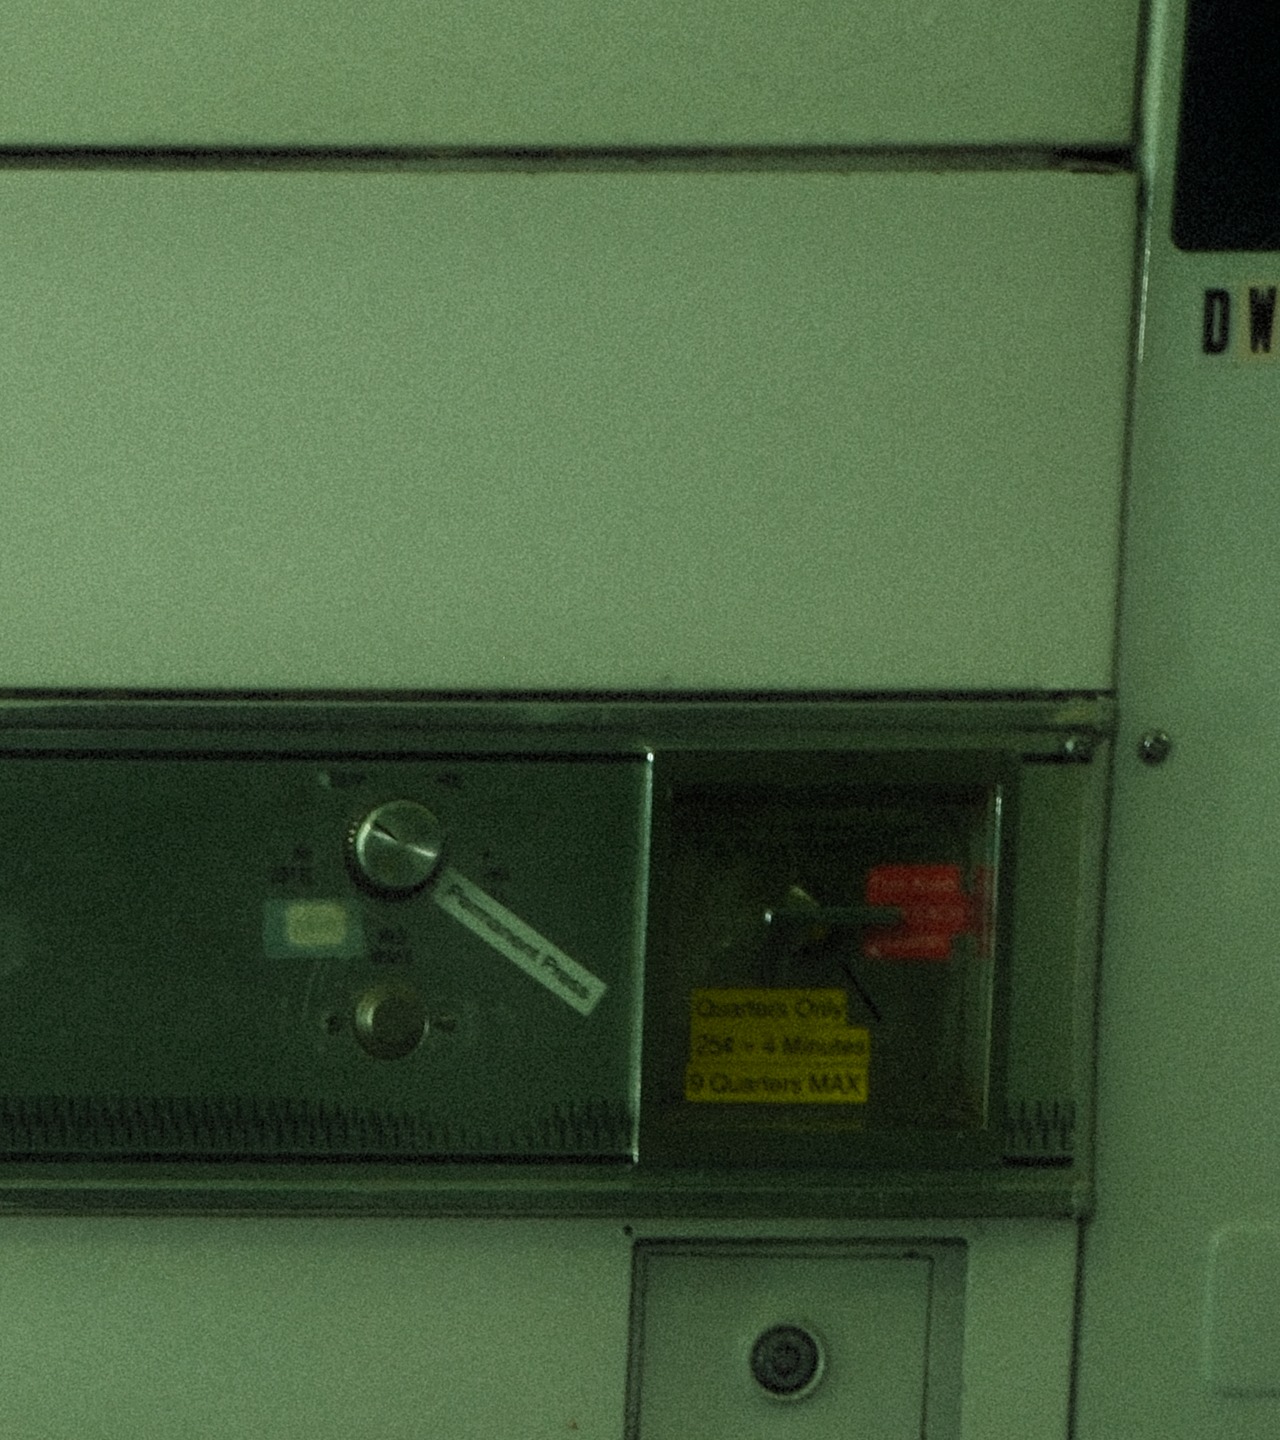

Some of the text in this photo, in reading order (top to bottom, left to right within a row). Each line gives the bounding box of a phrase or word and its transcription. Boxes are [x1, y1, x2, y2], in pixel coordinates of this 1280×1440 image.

[1202, 287, 1278, 355] DW
[446, 884, 540, 962] Permanent
[541, 956, 590, 1001] Press
[695, 998, 843, 1020] Quarters Only
[782, 1036, 866, 1055] Minutes
[688, 1072, 860, 1094] 9 Quarters MAX
